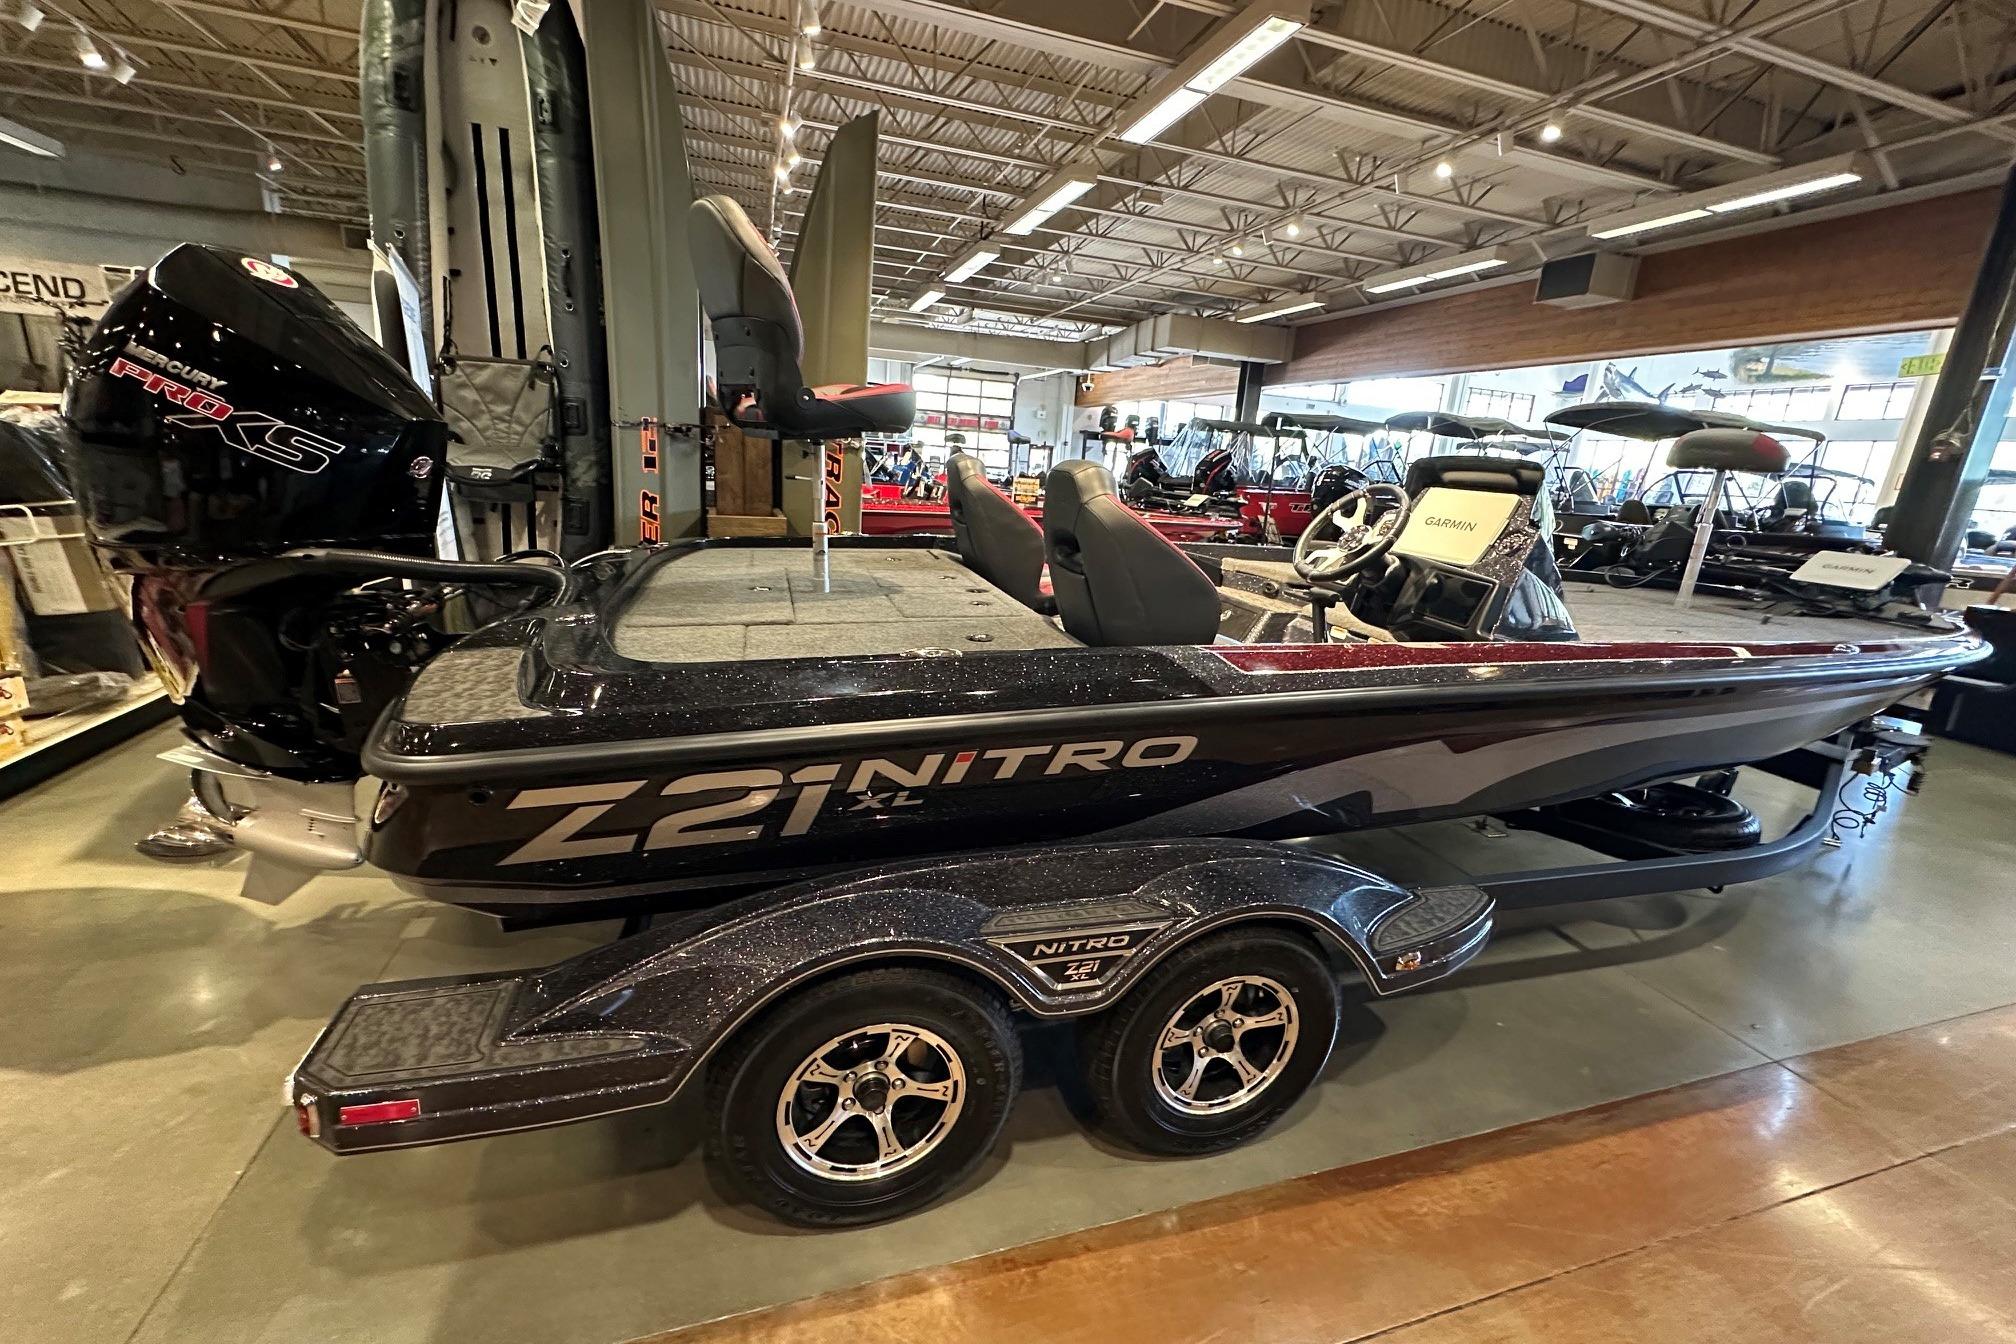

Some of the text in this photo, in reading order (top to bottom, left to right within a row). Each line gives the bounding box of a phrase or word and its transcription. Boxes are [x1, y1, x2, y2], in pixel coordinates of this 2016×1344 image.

[123, 340, 228, 389] MERCURY
[109, 356, 234, 421] PRO
[165, 410, 345, 474] XS
[1425, 516, 1478, 532] GARMIN
[1822, 564, 1875, 574] GARMIN
[495, 764, 840, 866] Z21
[847, 790, 925, 811] XL
[1064, 961, 1101, 975] Z21
